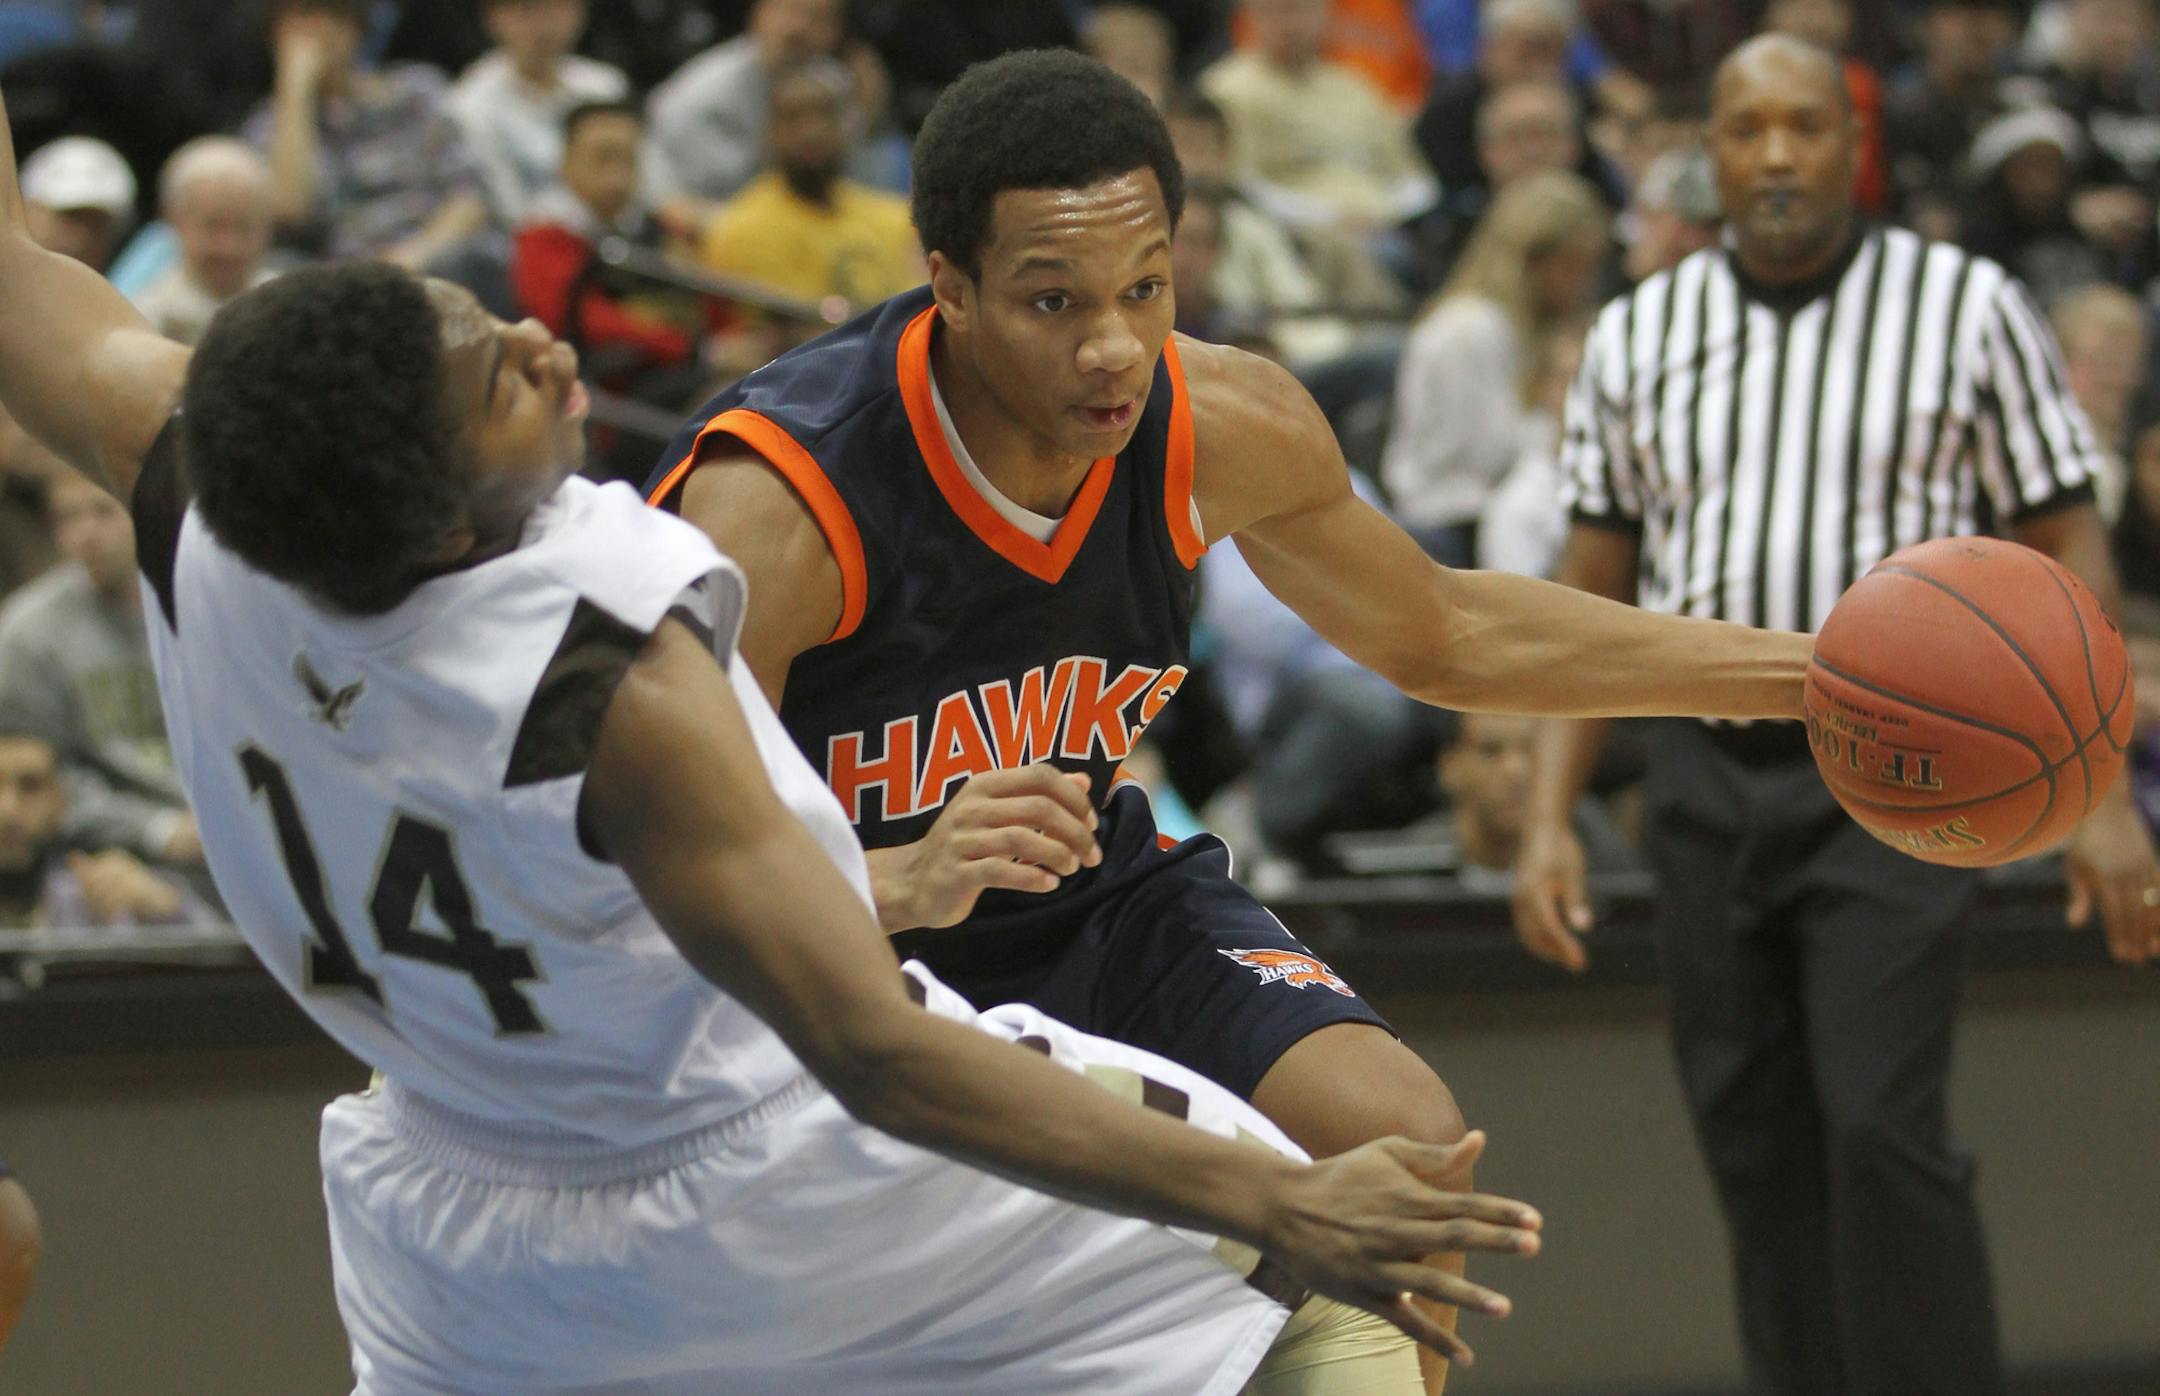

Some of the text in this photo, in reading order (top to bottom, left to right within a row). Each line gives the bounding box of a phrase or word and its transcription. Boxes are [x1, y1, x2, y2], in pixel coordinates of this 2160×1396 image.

[827, 655, 1188, 824] HAWKS
[236, 738, 558, 1037] 14
[1262, 963, 1313, 981] HAWKS
